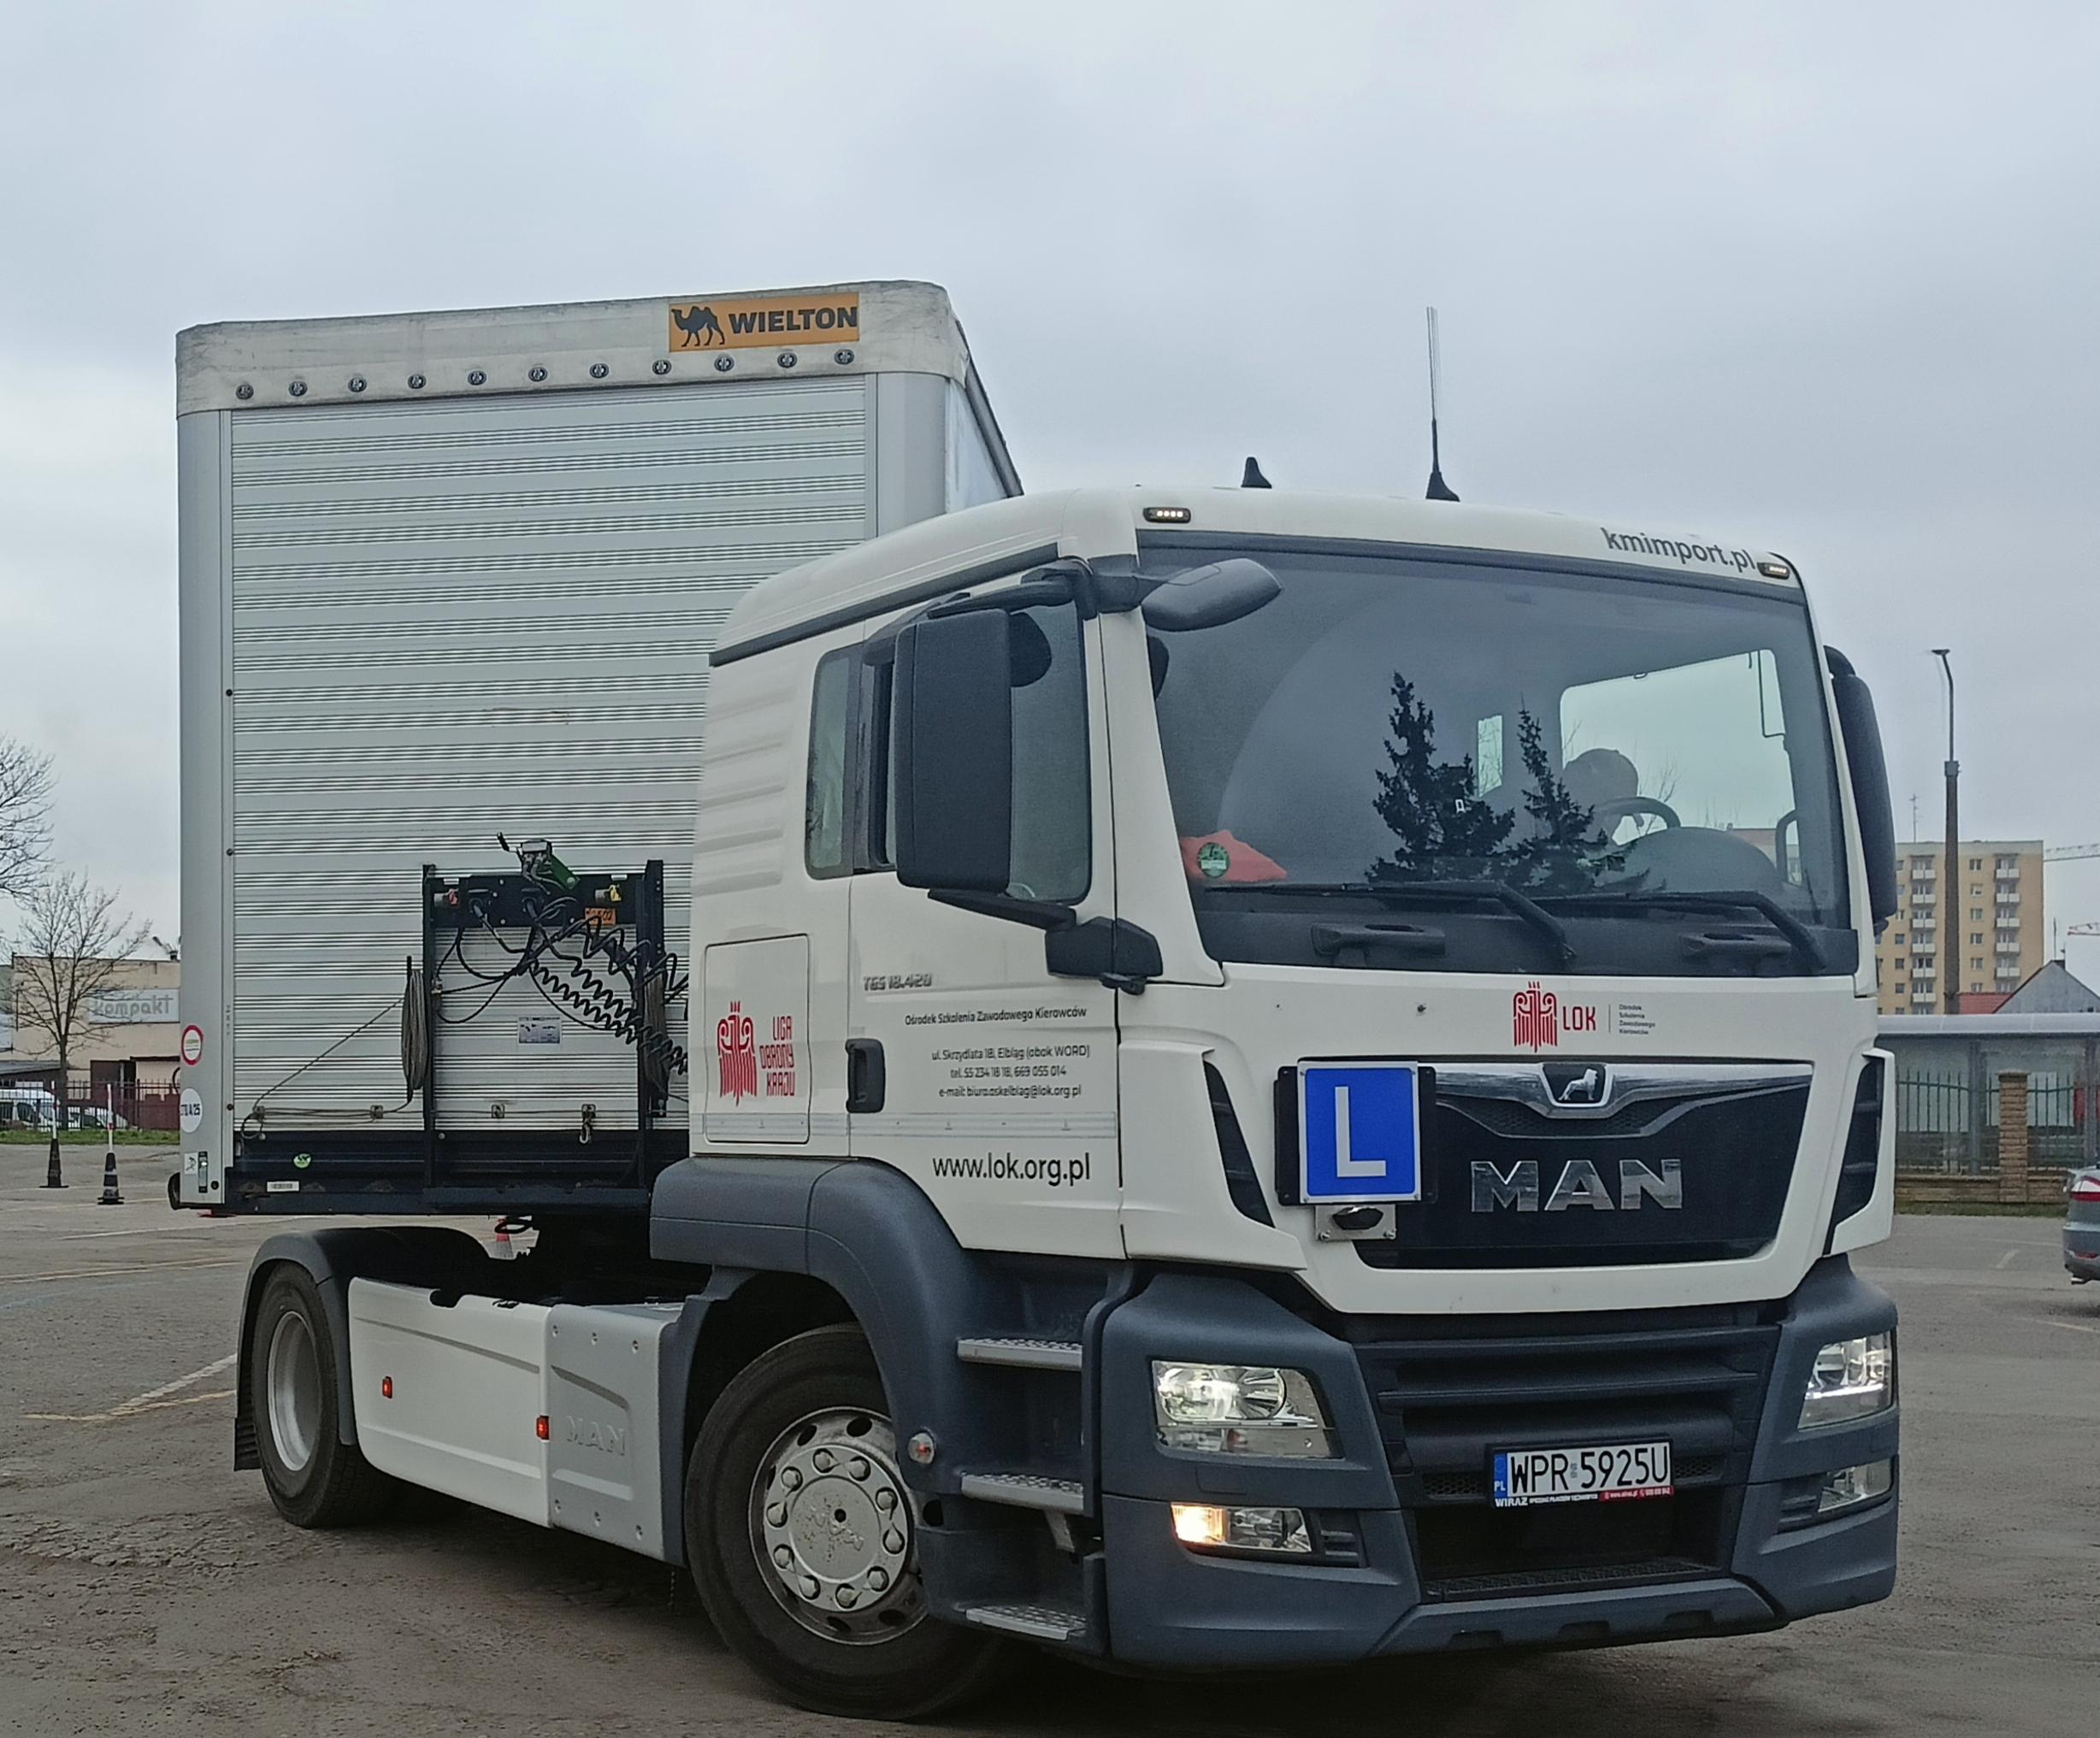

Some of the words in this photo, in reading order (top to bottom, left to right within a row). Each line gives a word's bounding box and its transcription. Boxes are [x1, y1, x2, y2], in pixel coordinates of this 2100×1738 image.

[729, 306, 858, 334] WIELTON
[1601, 527, 1756, 573] kmimport.pl
[772, 1016, 793, 1040] LIGA
[905, 1014, 936, 1026] Ośrodek
[938, 1010, 975, 1024] Szkolenia
[976, 1007, 1034, 1022] Zawodowego
[1035, 1005, 1087, 1020] Kierowców
[1562, 1005, 1596, 1031] LOK
[759, 1044, 794, 1069] OBRONY
[1054, 1045, 1090, 1058] WORD)
[766, 1071, 795, 1096] KRAJU
[1336, 1087, 1386, 1177] L
[933, 1152, 1090, 1187] www.lok.org.pl
[1471, 1159, 1683, 1213] MAN
[1511, 1453, 1569, 1494] WPR
[1580, 1446, 1668, 1489] 5925U
[1495, 1481, 1506, 1492] PL
